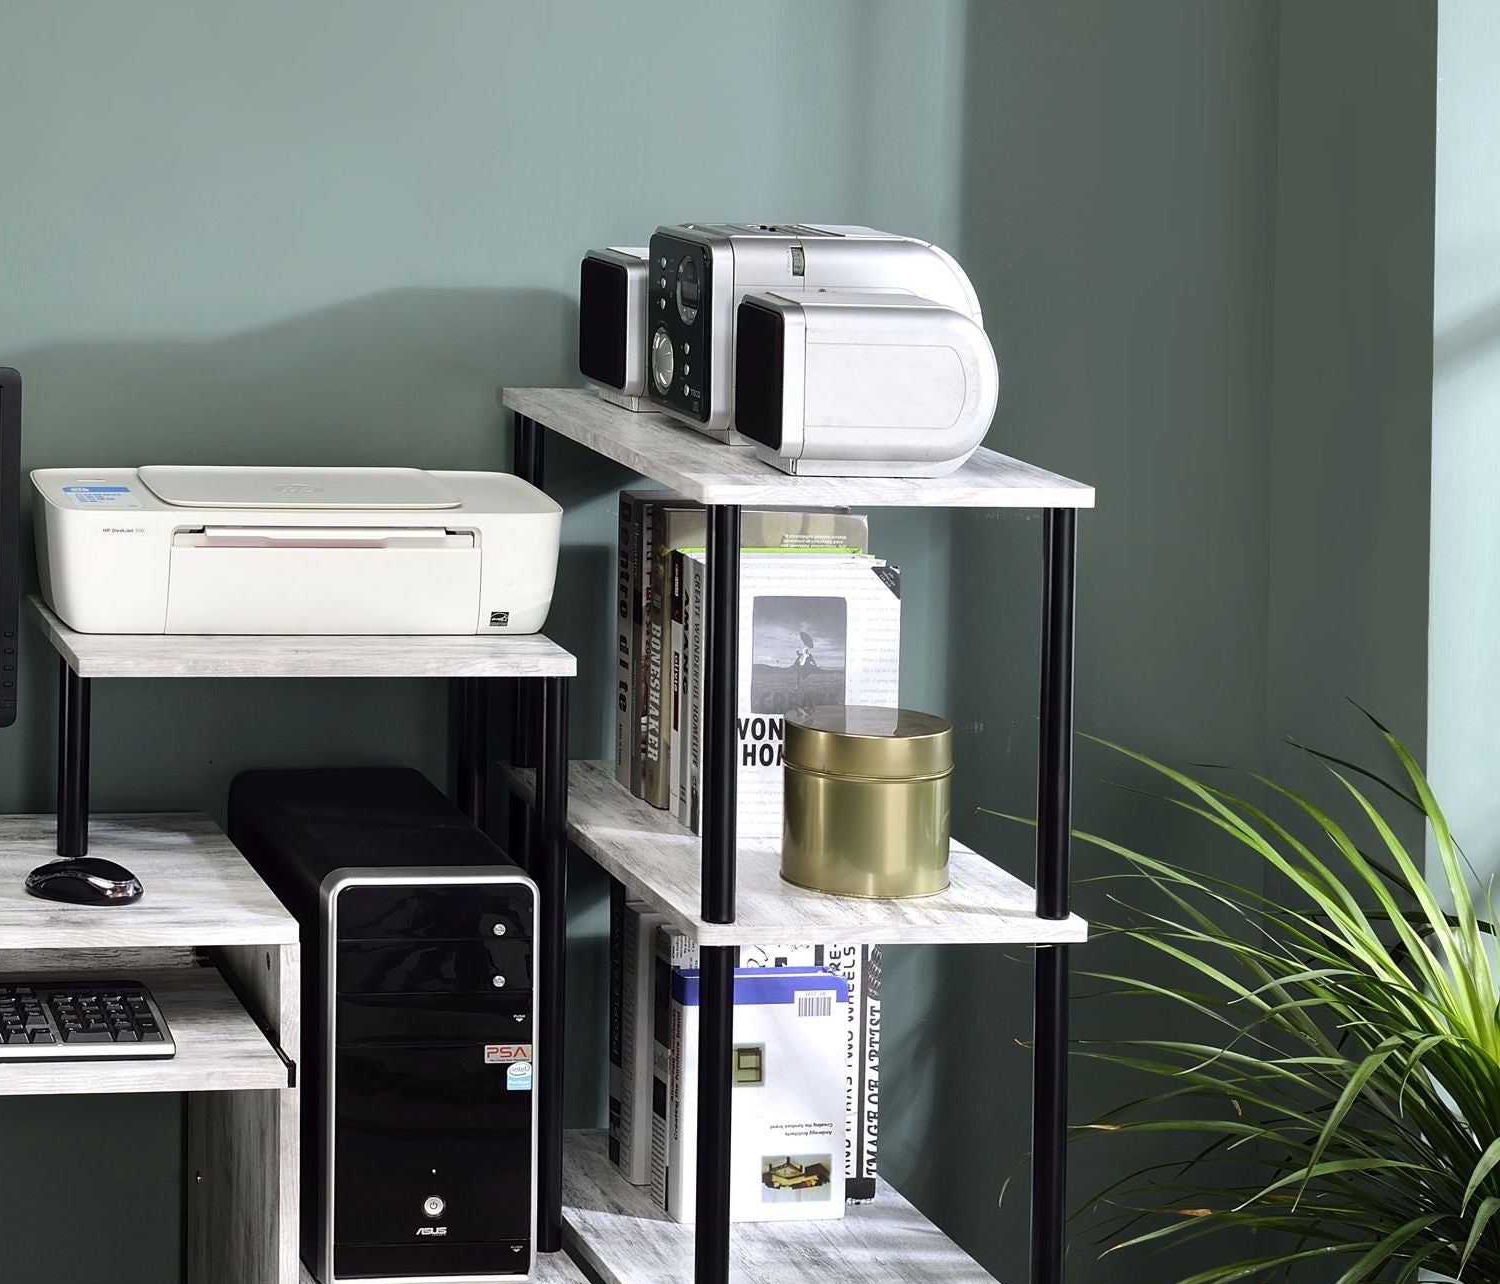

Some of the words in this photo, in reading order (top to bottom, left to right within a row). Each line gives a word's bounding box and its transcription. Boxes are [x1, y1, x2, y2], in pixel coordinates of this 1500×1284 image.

[619, 501, 632, 619] Dentro
[693, 573, 702, 618] CREATE
[619, 633, 630, 671] di
[691, 623, 702, 699] WONDERFUL
[618, 679, 629, 713] te
[647, 623, 662, 762] BONESHAKER
[690, 703, 700, 768] HOMELIFE
[486, 1046, 527, 1058] PSA
[416, 1227, 447, 1236] ASUS
